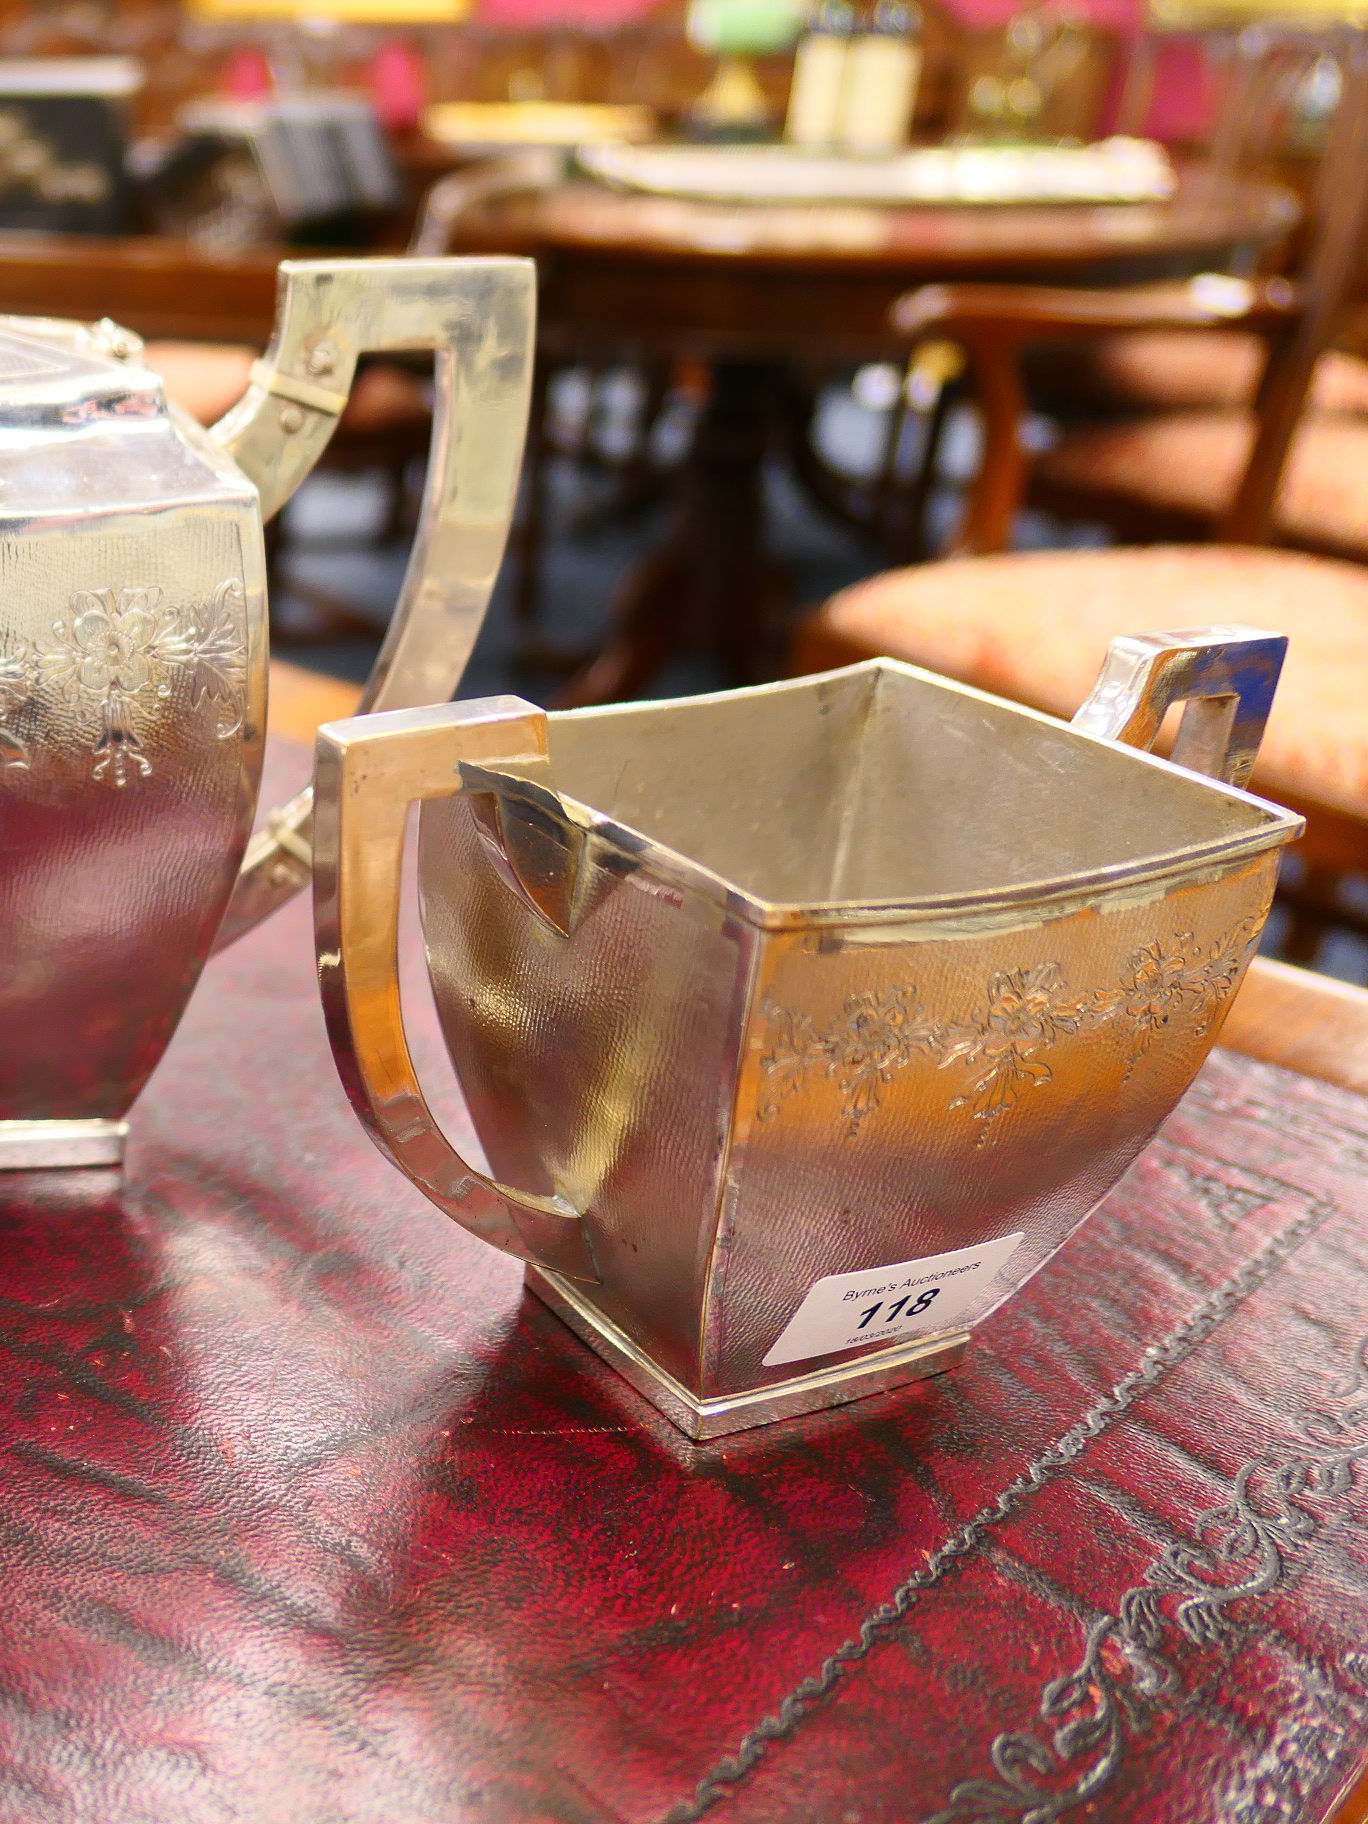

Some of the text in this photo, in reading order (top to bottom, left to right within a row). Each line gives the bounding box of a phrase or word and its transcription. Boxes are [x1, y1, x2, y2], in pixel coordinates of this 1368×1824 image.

[842, 1261, 982, 1301] Byrne's Auctioneers
[857, 1288, 940, 1329] 118
